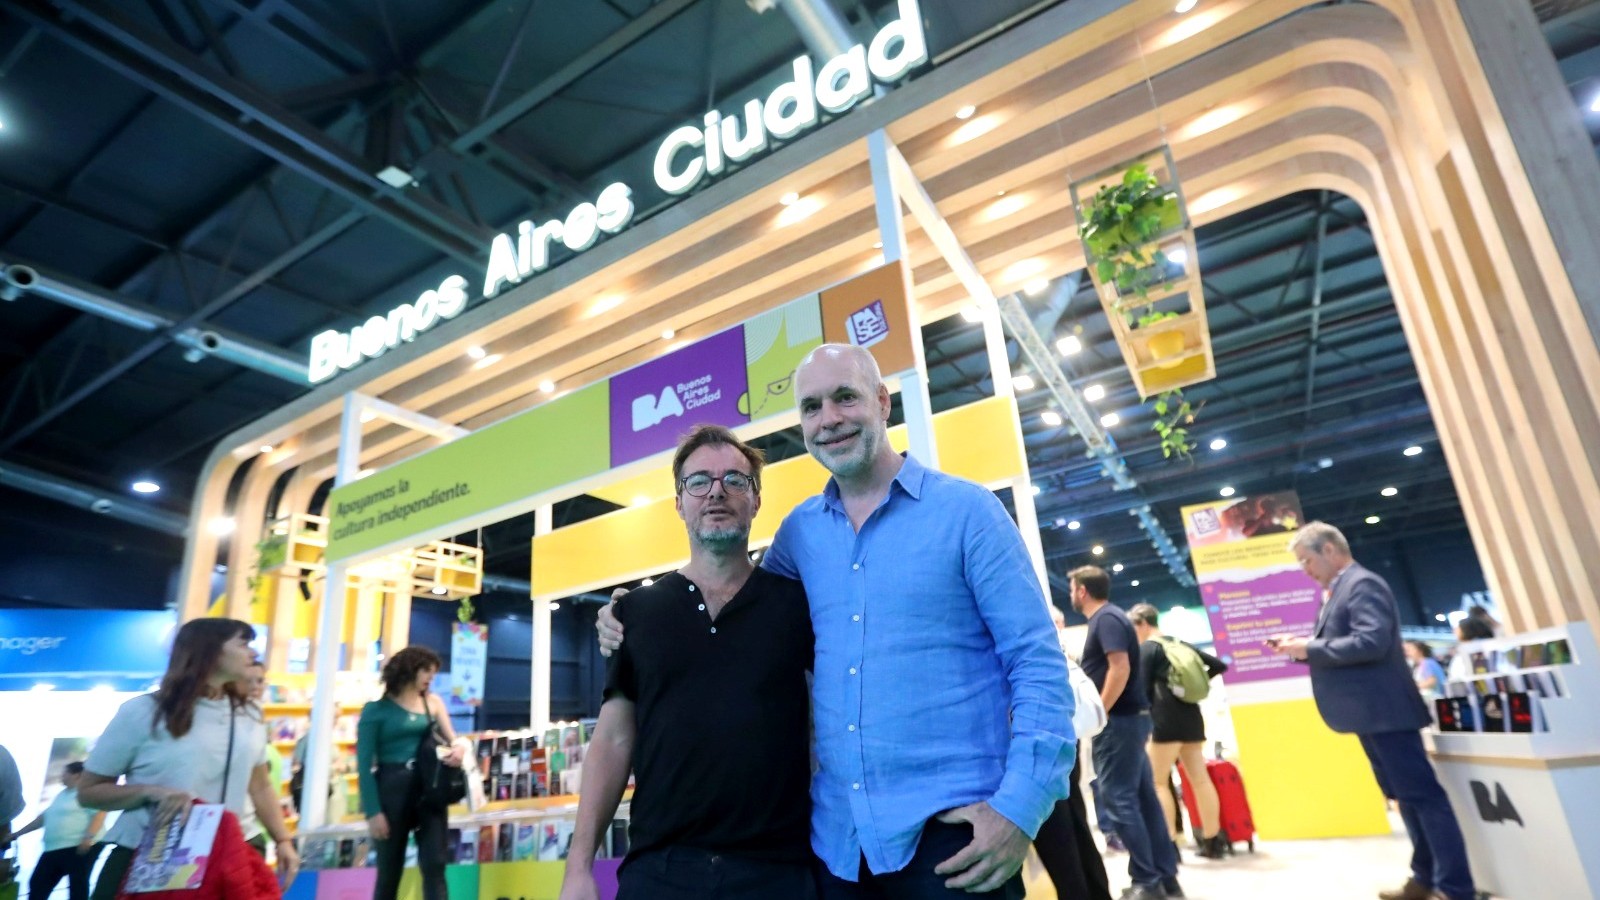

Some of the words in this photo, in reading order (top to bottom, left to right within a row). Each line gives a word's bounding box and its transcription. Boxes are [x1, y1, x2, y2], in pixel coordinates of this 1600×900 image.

[308, 274, 469, 383] Buenos
[483, 182, 634, 298] Aires
[653, 0, 928, 195] Ciudad
[677, 374, 712, 394] Buenos
[683, 385, 710, 402] Aires
[686, 389, 721, 410] Ciudad
[632, 386, 684, 432] BA
[333, 516, 375, 541] cultura
[377, 482, 471, 525] independiente.
[336, 485, 396, 517] Apoyamos
[398, 479, 410, 494] la
[1469, 780, 1525, 828] BA
